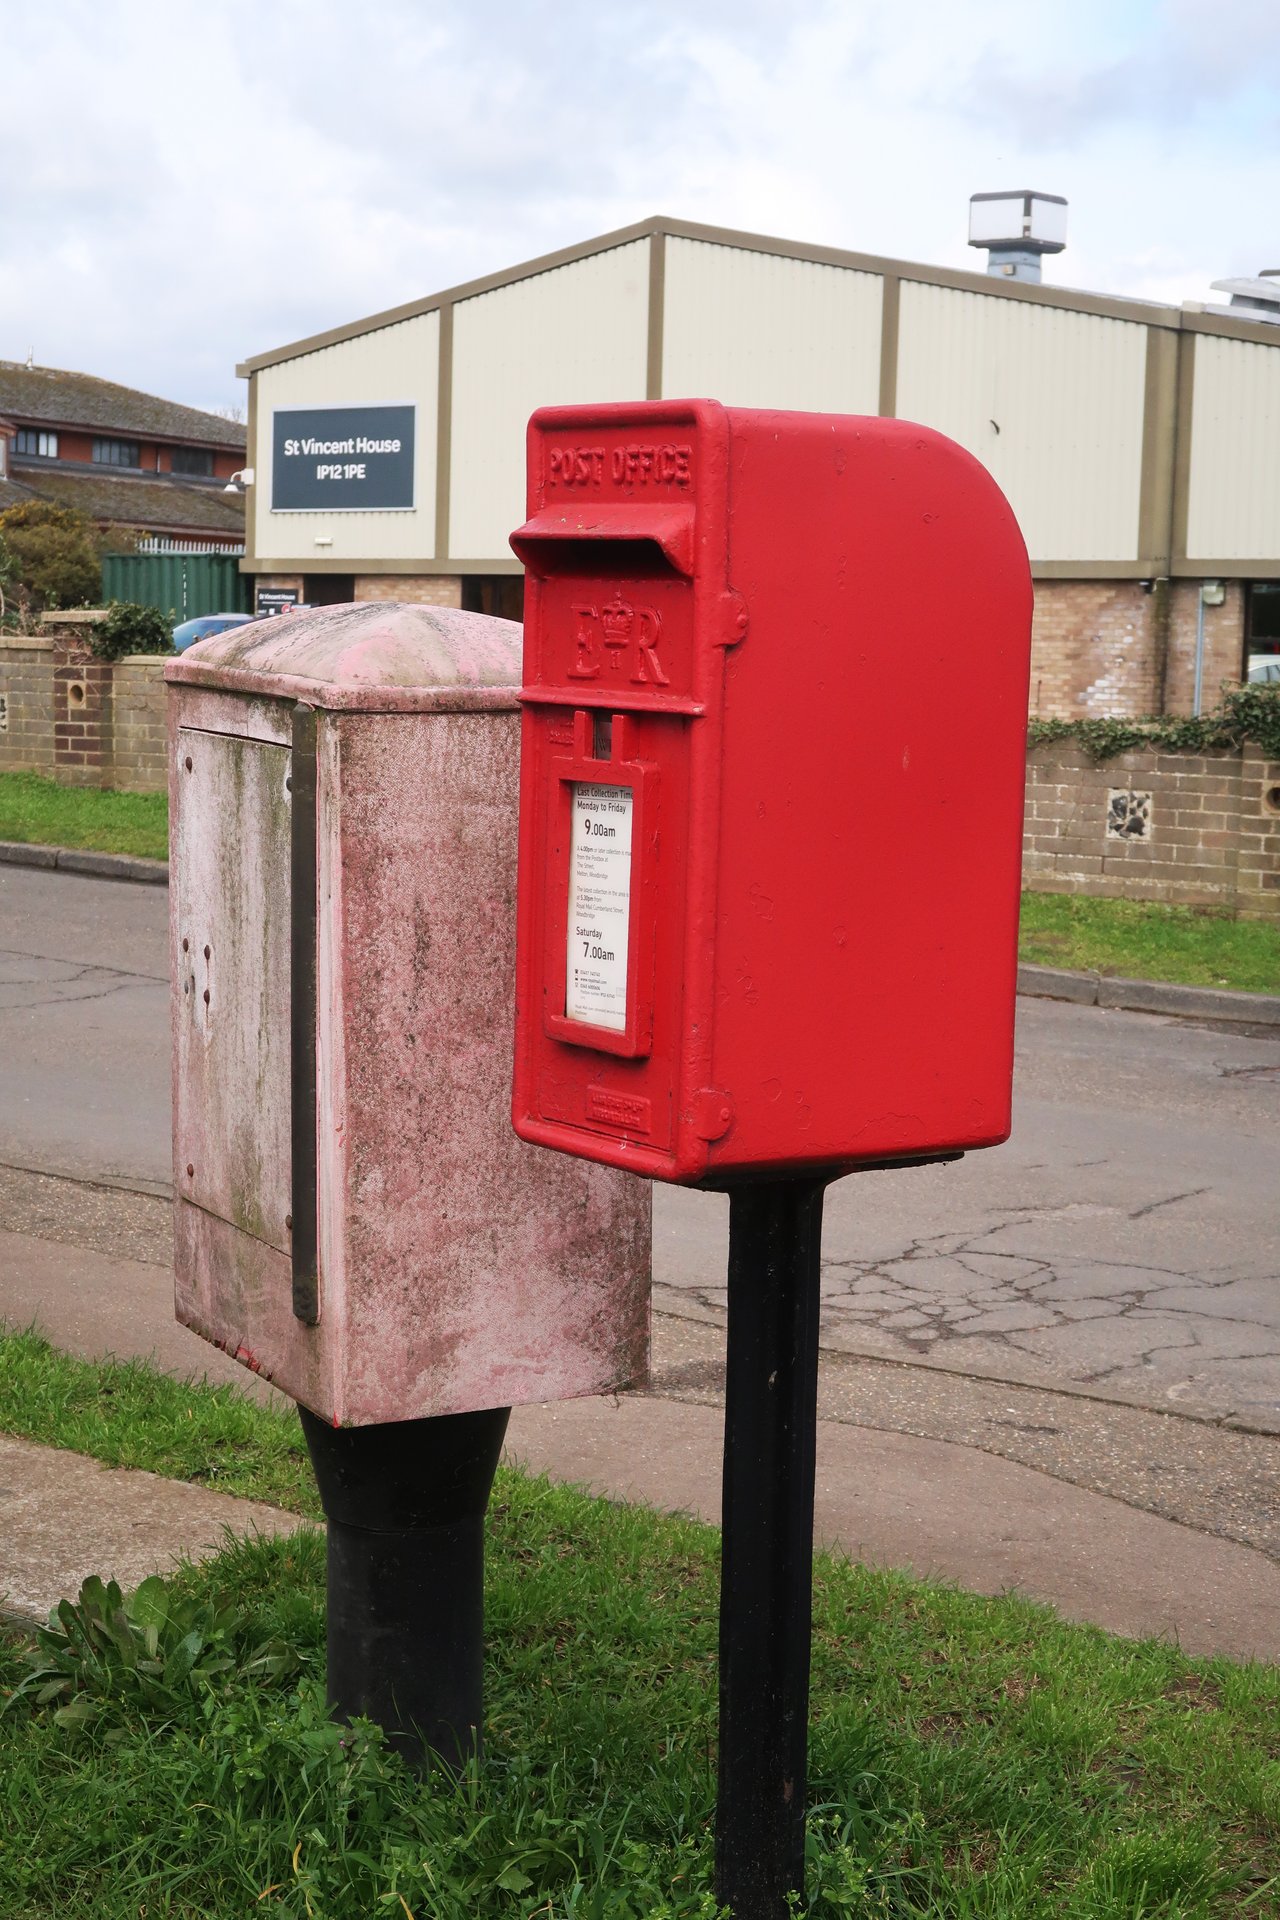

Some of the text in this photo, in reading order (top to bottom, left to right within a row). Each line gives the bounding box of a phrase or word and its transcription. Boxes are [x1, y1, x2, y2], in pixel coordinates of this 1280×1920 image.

[284, 437, 401, 456] St Vincent House
[316, 464, 366, 480] IP12 1PE
[550, 444, 693, 487] POST OFFICE
[265, 592, 281, 600] Vincent
[629, 608, 671, 688] R
[577, 787, 589, 797] Last
[590, 788, 618, 799] Collection
[577, 800, 627, 815] Monday to Friday
[584, 818, 616, 838] 9.00am
[576, 926, 603, 940] Saturday
[583, 942, 615, 961] 7.00am
